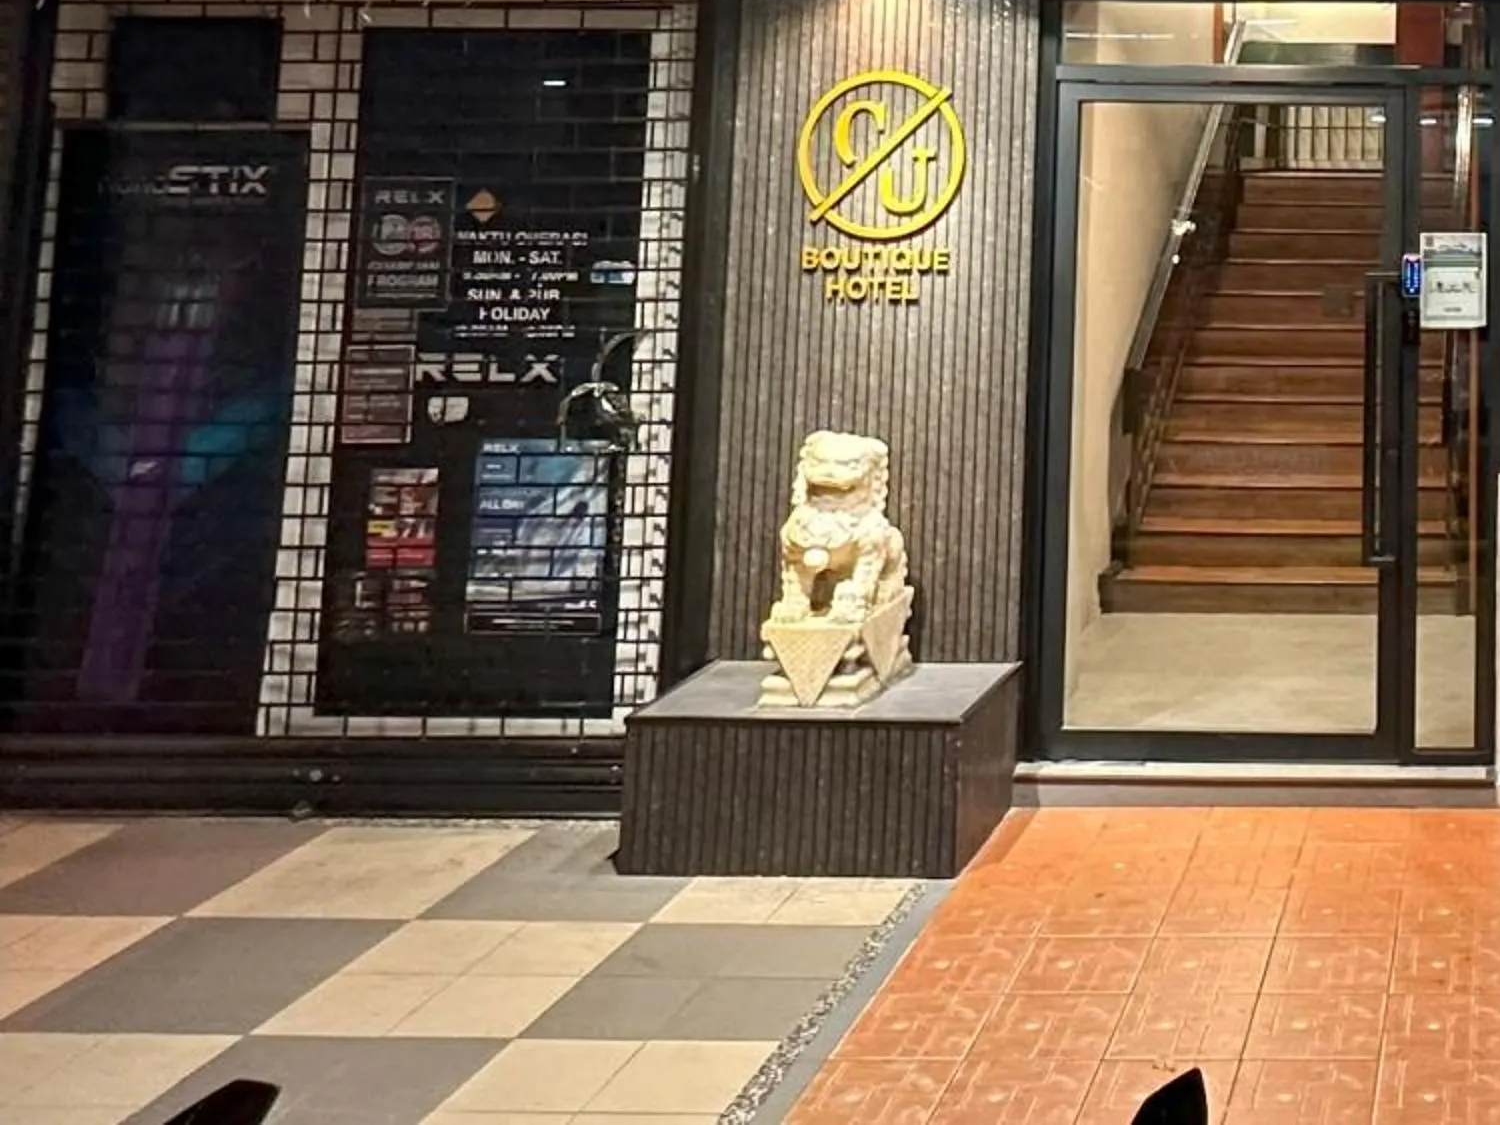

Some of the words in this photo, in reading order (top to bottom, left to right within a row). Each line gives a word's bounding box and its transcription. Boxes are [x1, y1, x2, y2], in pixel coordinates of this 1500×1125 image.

[374, 190, 445, 204] RELX
[801, 247, 951, 271] BOUTIQUE
[825, 276, 920, 300] HOTEL
[478, 307, 551, 321] HOLIDAY
[415, 352, 560, 383] RELX
